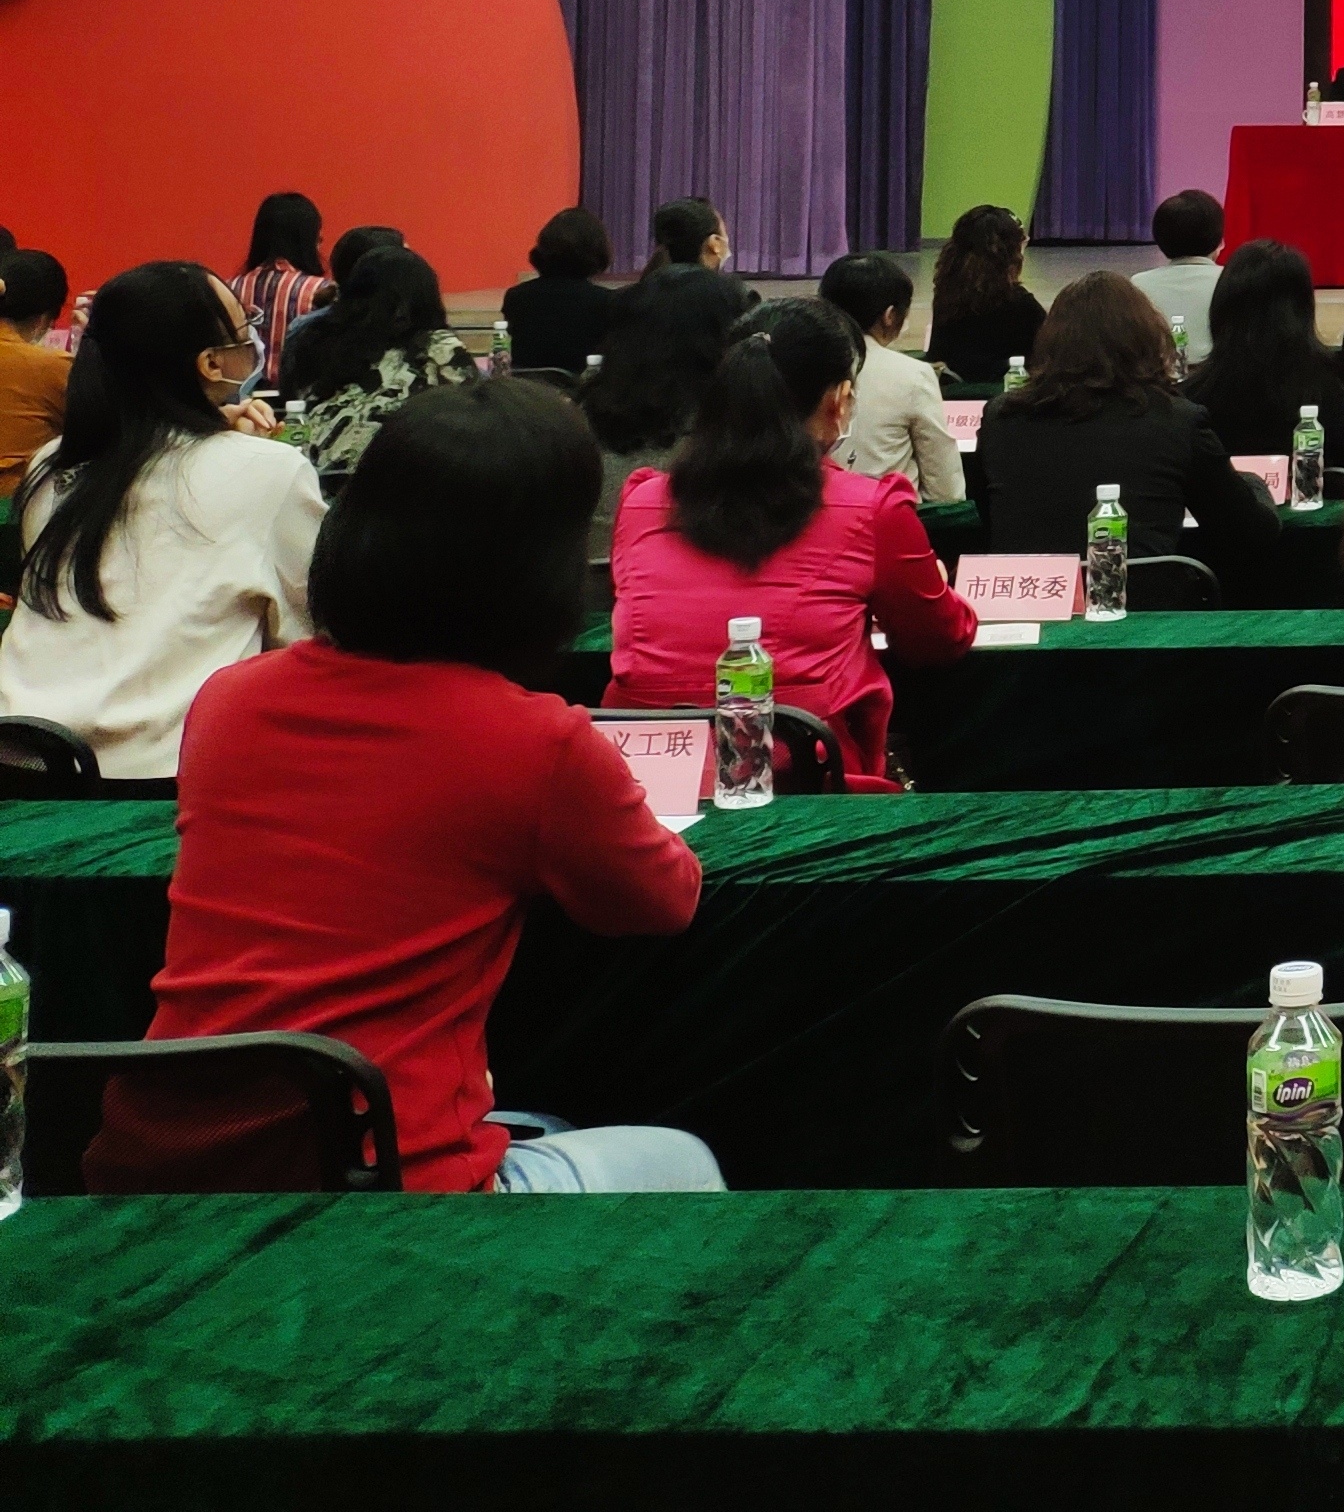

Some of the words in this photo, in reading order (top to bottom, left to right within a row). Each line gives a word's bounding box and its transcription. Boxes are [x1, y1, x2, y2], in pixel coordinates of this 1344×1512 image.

[965, 575, 1068, 600] 市国资委
[1275, 1081, 1313, 1104] ipini
